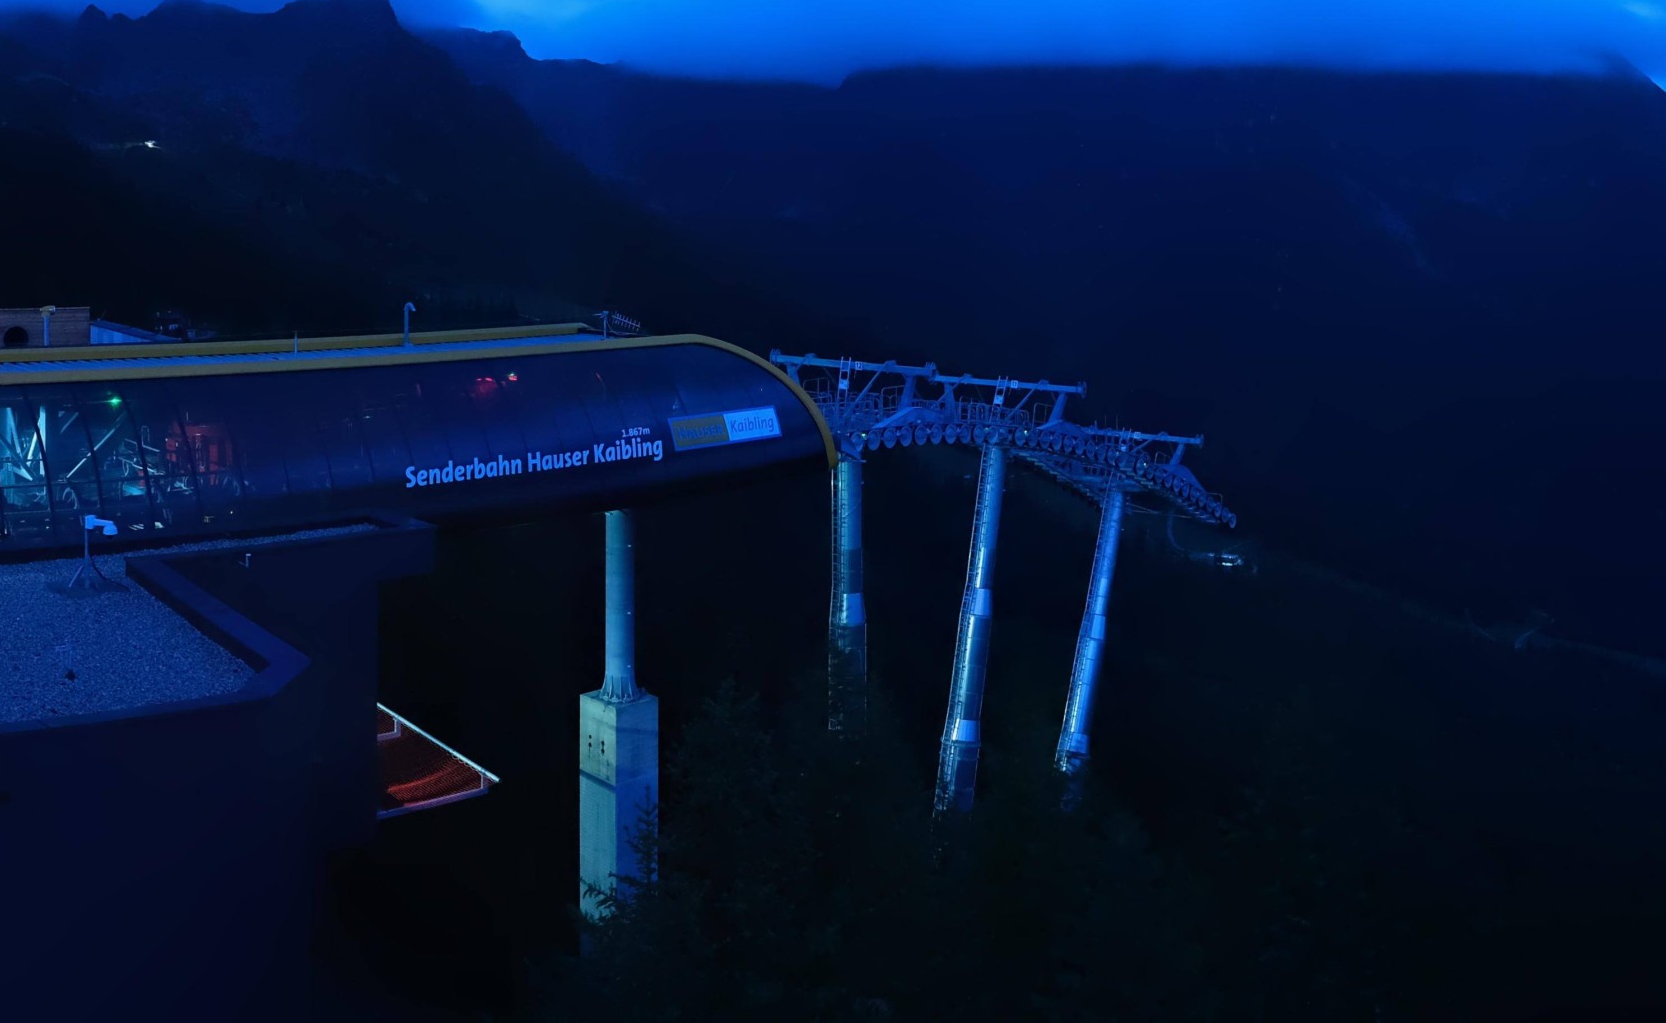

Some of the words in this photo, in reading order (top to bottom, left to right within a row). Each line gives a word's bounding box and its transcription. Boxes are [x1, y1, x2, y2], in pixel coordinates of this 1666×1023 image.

[621, 427, 651, 438] 1.867m
[730, 416, 774, 434] Kaibling
[405, 455, 522, 488] Senderbahn
[527, 447, 589, 473] Hauser
[594, 437, 663, 464] Kaibling
